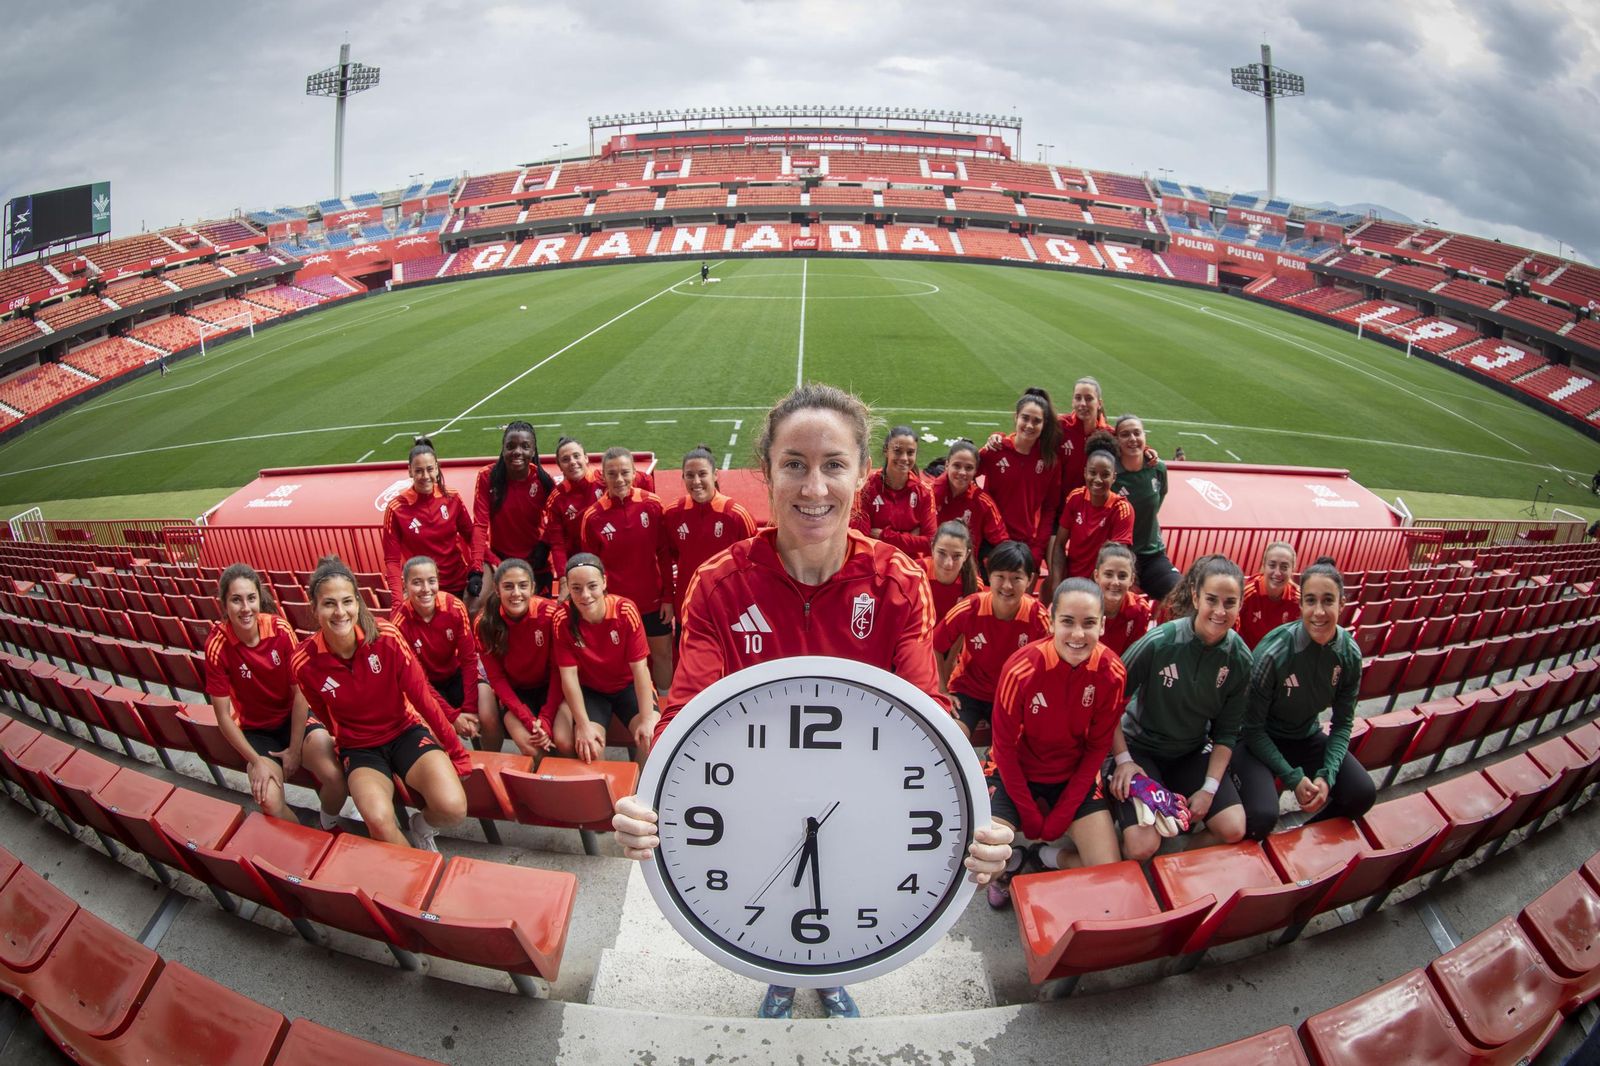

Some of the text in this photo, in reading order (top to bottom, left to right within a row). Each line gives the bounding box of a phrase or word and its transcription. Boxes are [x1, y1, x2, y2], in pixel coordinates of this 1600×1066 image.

[744, 135, 786, 143] Bienvenidos
[1240, 212, 1272, 225] PULEVA
[1177, 236, 1215, 252] PULEVA
[1227, 245, 1265, 262] PULEVA
[1277, 255, 1307, 271] PULEVA
[743, 634, 763, 654] 10
[974, 642, 983, 650] 14
[1162, 676, 1174, 688] 13
[329, 689, 336, 699] 7
[1031, 704, 1040, 714] 6
[747, 724, 766, 749] 11
[789, 705, 843, 750] 12
[872, 727, 879, 751] 1
[704, 762, 734, 786] 10
[903, 766, 925, 790] 2
[684, 806, 724, 846] 9
[907, 811, 943, 851] 3
[706, 869, 729, 891] 8
[897, 873, 920, 894] 4
[744, 905, 765, 926] 7
[857, 908, 879, 929] 5
[790, 908, 831, 945] 6
